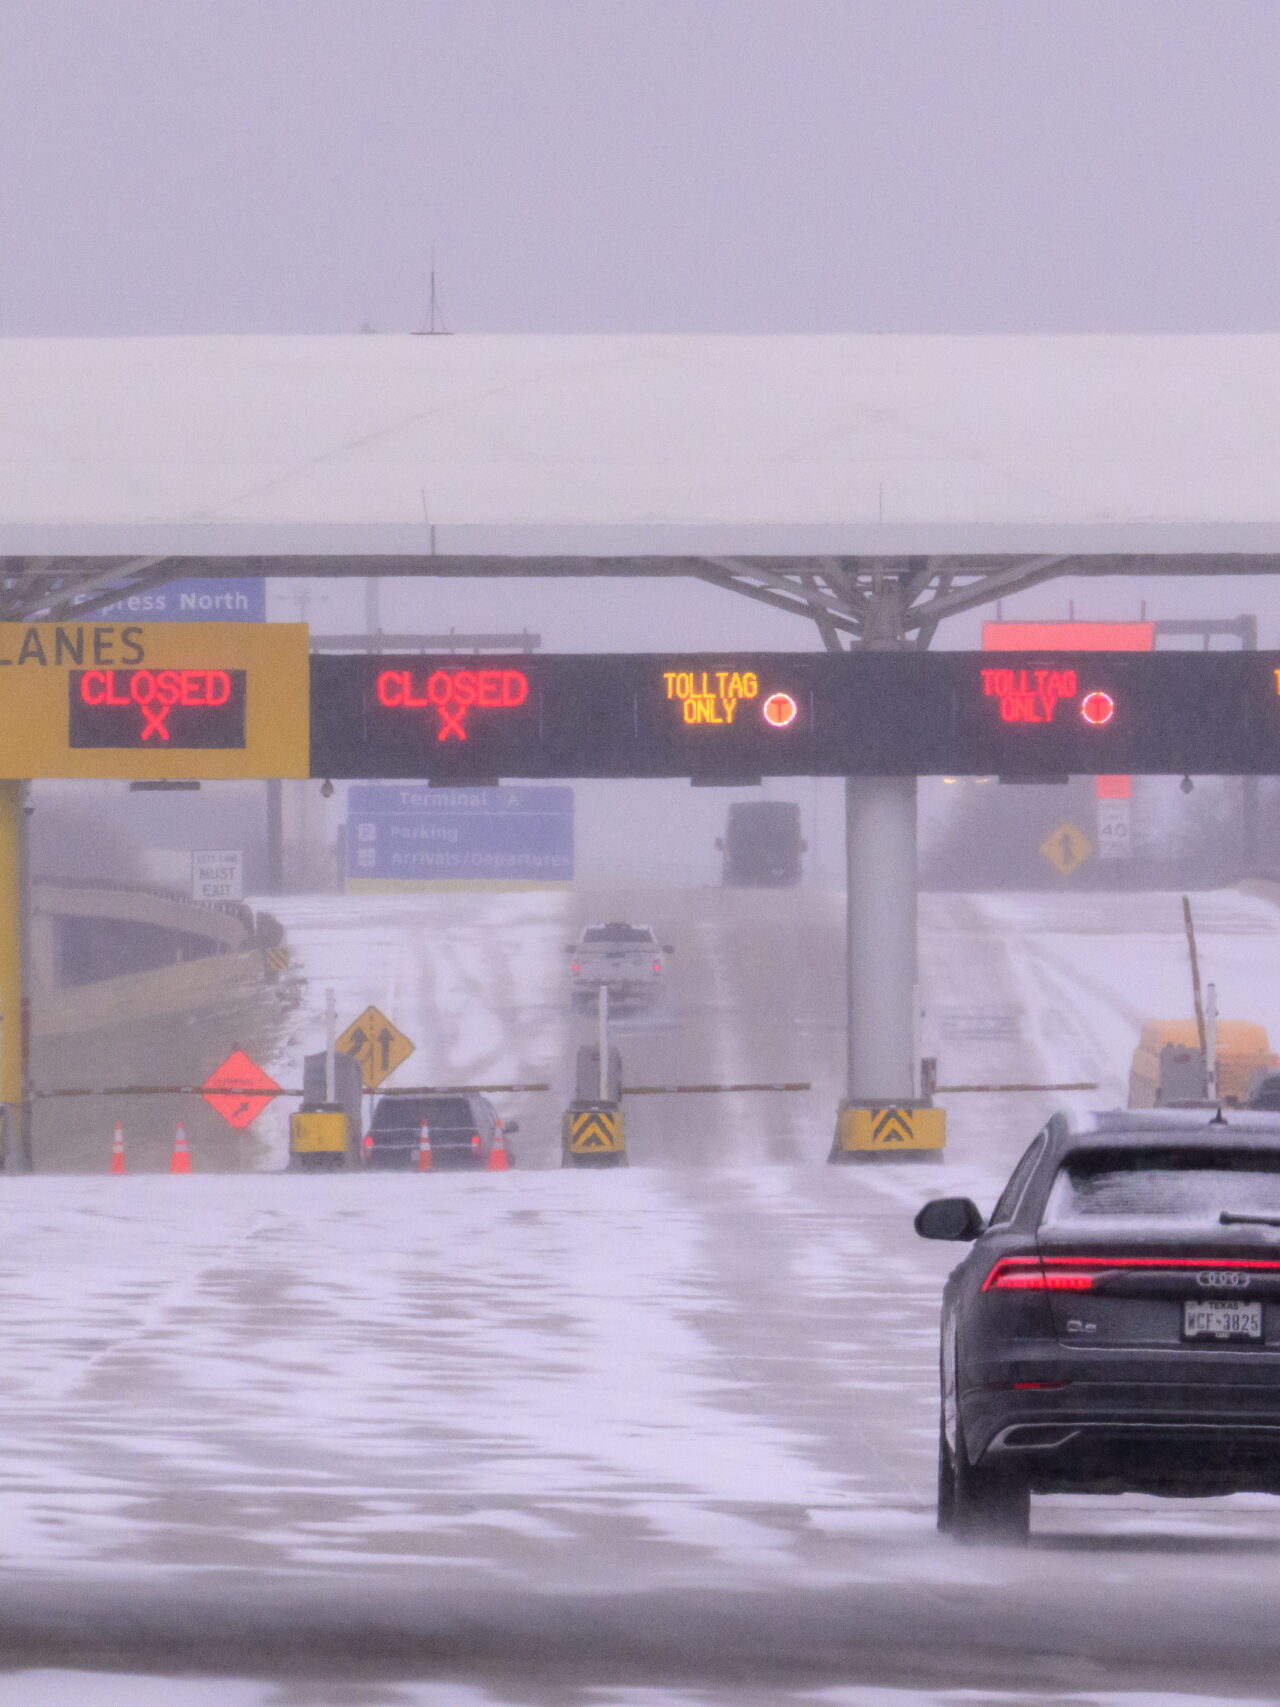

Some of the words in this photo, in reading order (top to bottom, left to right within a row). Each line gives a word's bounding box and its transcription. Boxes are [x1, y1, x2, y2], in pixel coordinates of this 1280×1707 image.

[179, 591, 249, 611] North
[80, 669, 231, 706] CLOSED
[377, 670, 529, 707] CLOSED
[683, 698, 737, 724] ONLY
[1000, 694, 1057, 723] ONLY
[400, 791, 488, 807] Terminal
[507, 793, 521, 807] A
[391, 825, 459, 843] Parking
[1101, 824, 1128, 839] 40
[391, 852, 571, 868] Arrivals/Departures
[199, 867, 236, 880] MUST
[202, 884, 231, 897] EXIT
[1209, 1302, 1239, 1310] TEXAS
